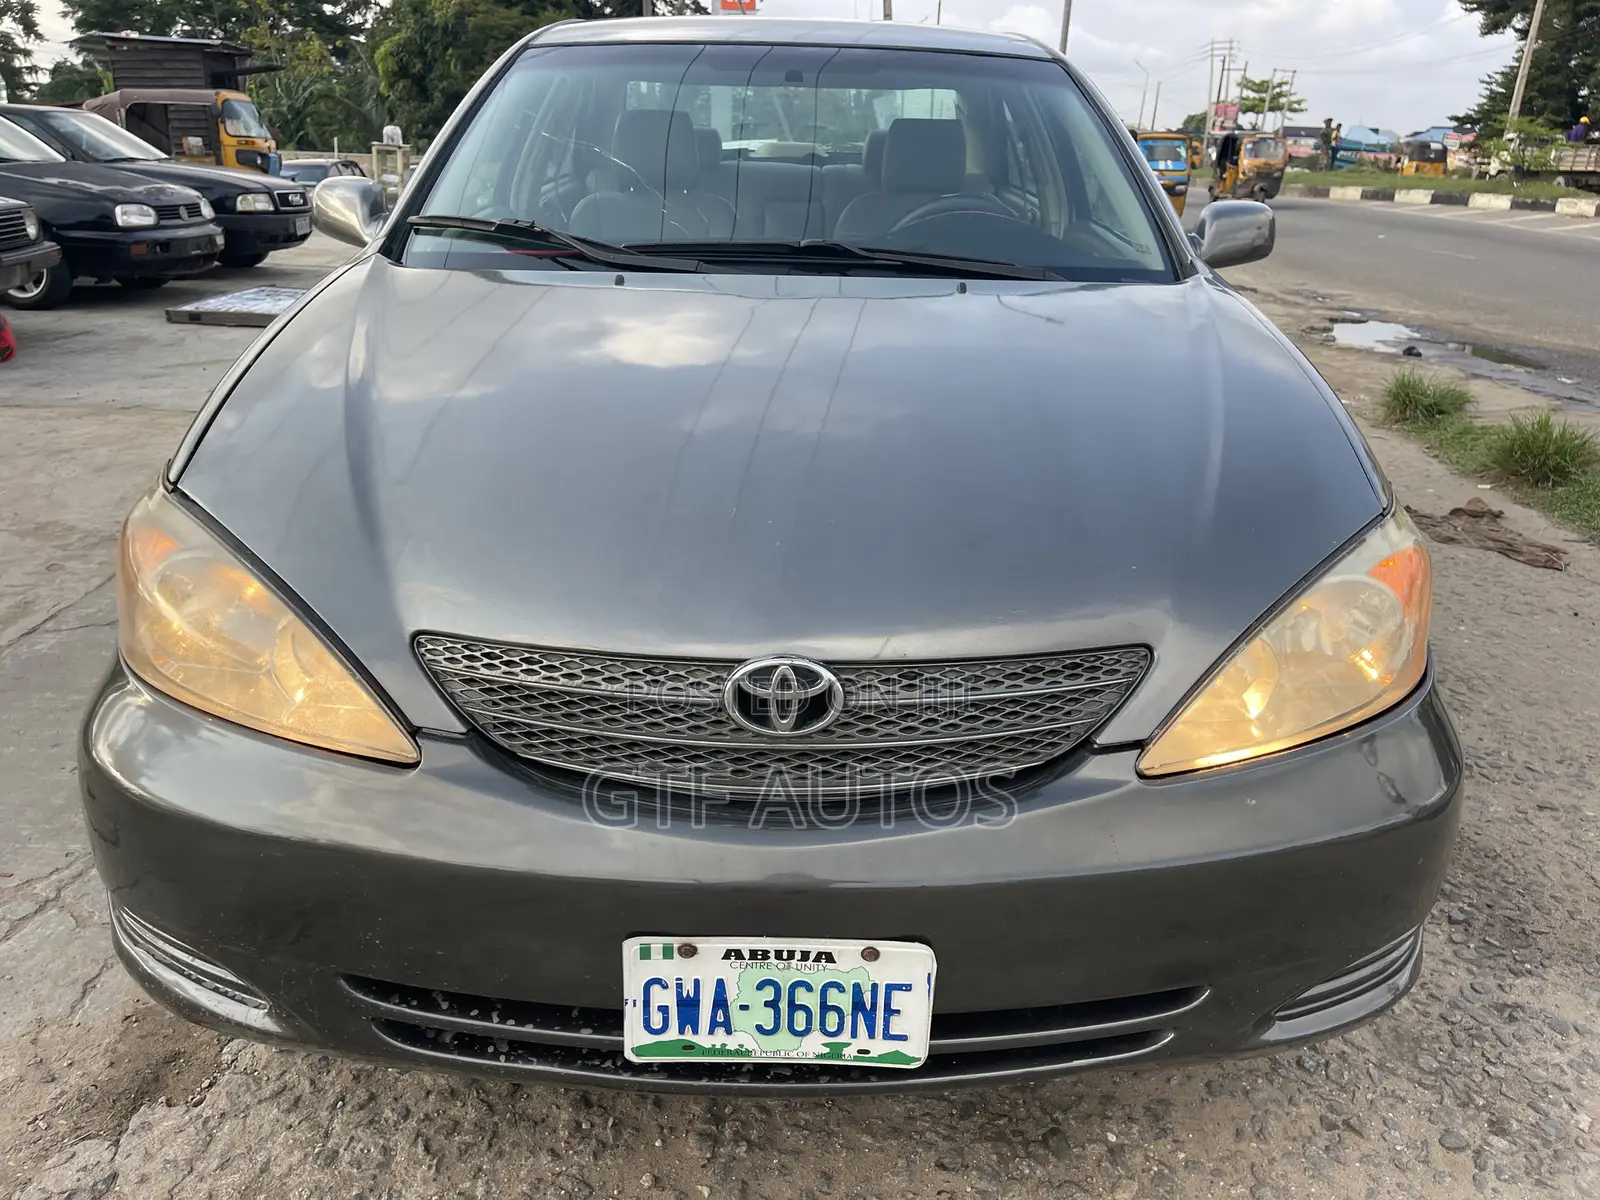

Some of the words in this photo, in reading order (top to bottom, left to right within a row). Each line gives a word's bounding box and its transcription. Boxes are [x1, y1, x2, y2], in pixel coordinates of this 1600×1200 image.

[721, 948, 837, 964] ABUJA
[729, 961, 773, 970] CENTRE
[775, 962, 792, 971] OF
[795, 963, 828, 972] UNITY
[642, 977, 912, 1041] GWA-366NE
[702, 1049, 748, 1057] FEDERAL
[748, 1049, 792, 1058] REPUBLIC
[796, 1050, 810, 1058] OF
[813, 1051, 853, 1060] NIGERIA
